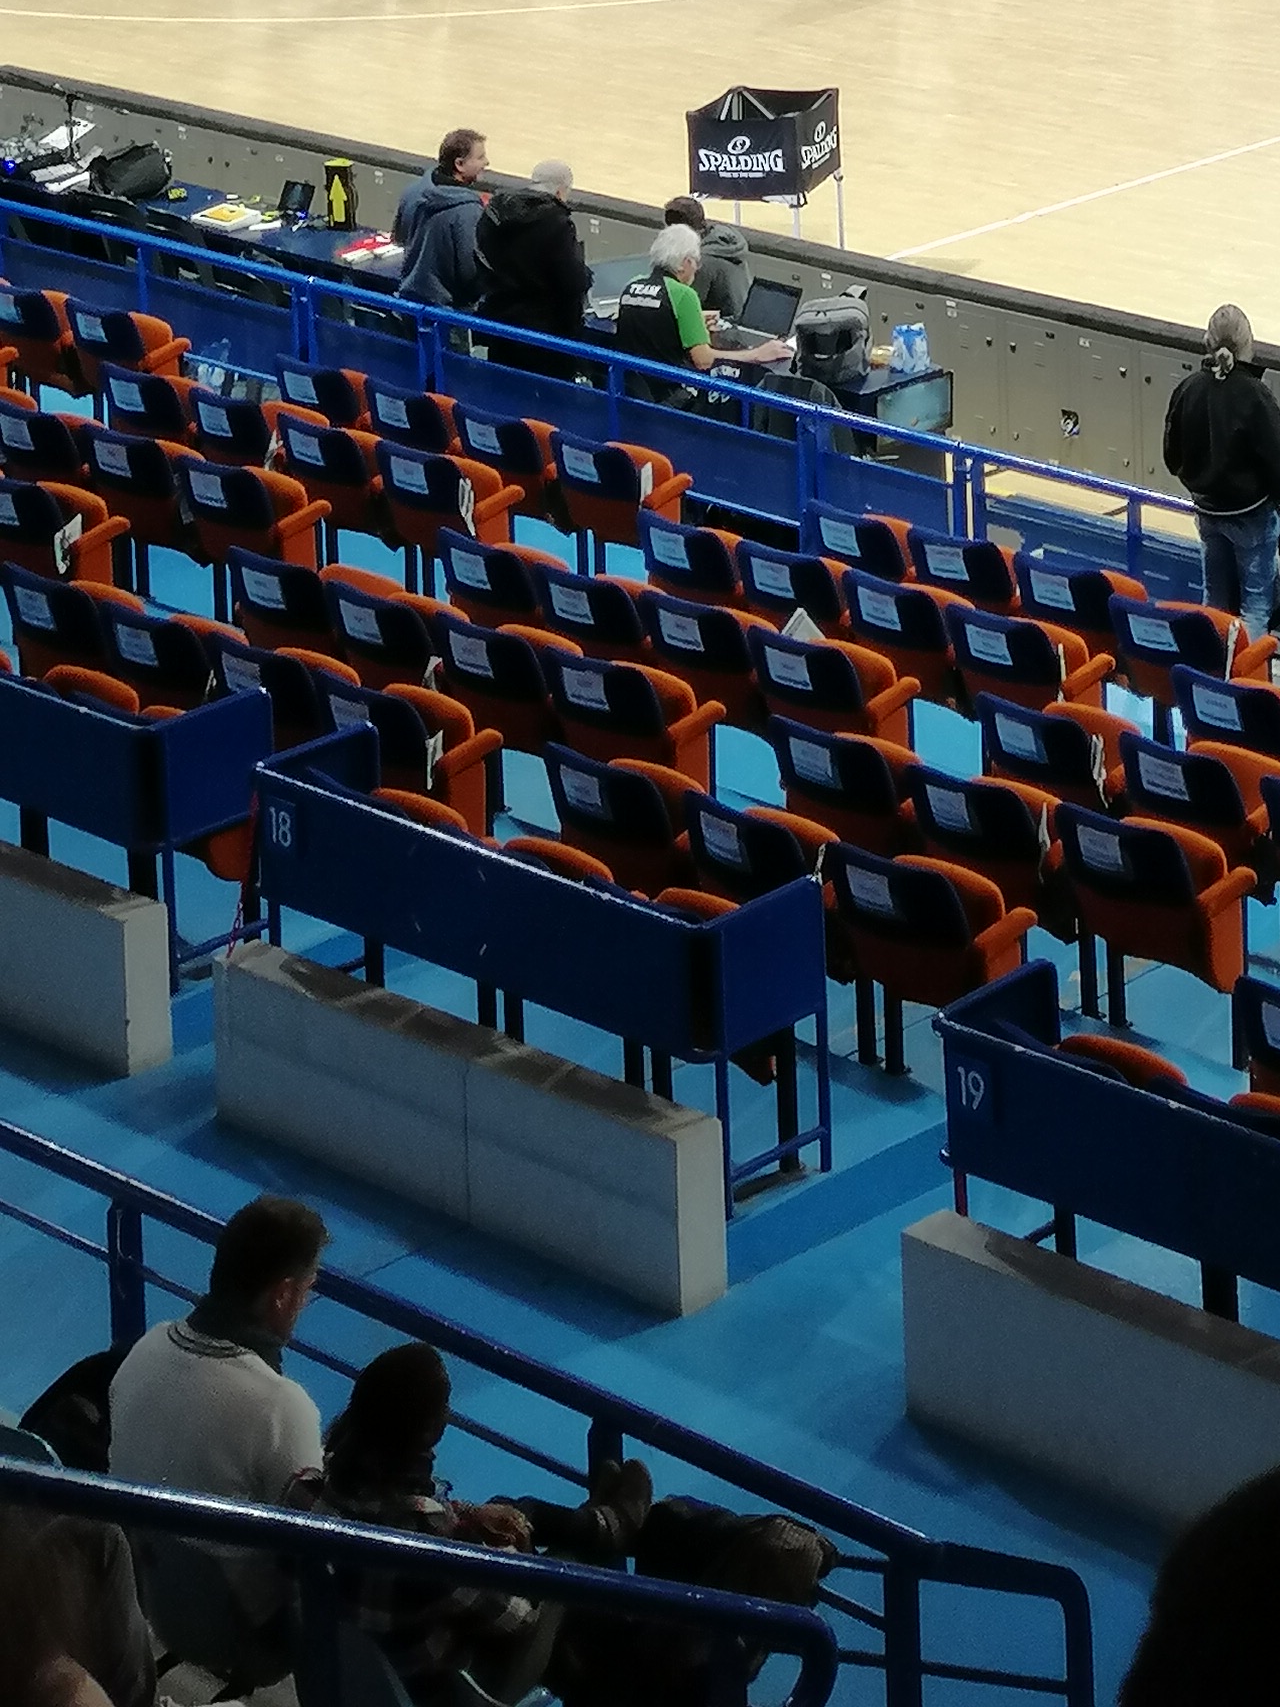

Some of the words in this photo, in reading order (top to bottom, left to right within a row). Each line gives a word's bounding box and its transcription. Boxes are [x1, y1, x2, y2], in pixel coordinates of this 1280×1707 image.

[698, 148, 786, 173] SPALDING
[801, 125, 838, 170] SPALDING
[629, 284, 663, 297] TEAM
[269, 805, 292, 848] 18
[957, 1065, 985, 1111] 19
